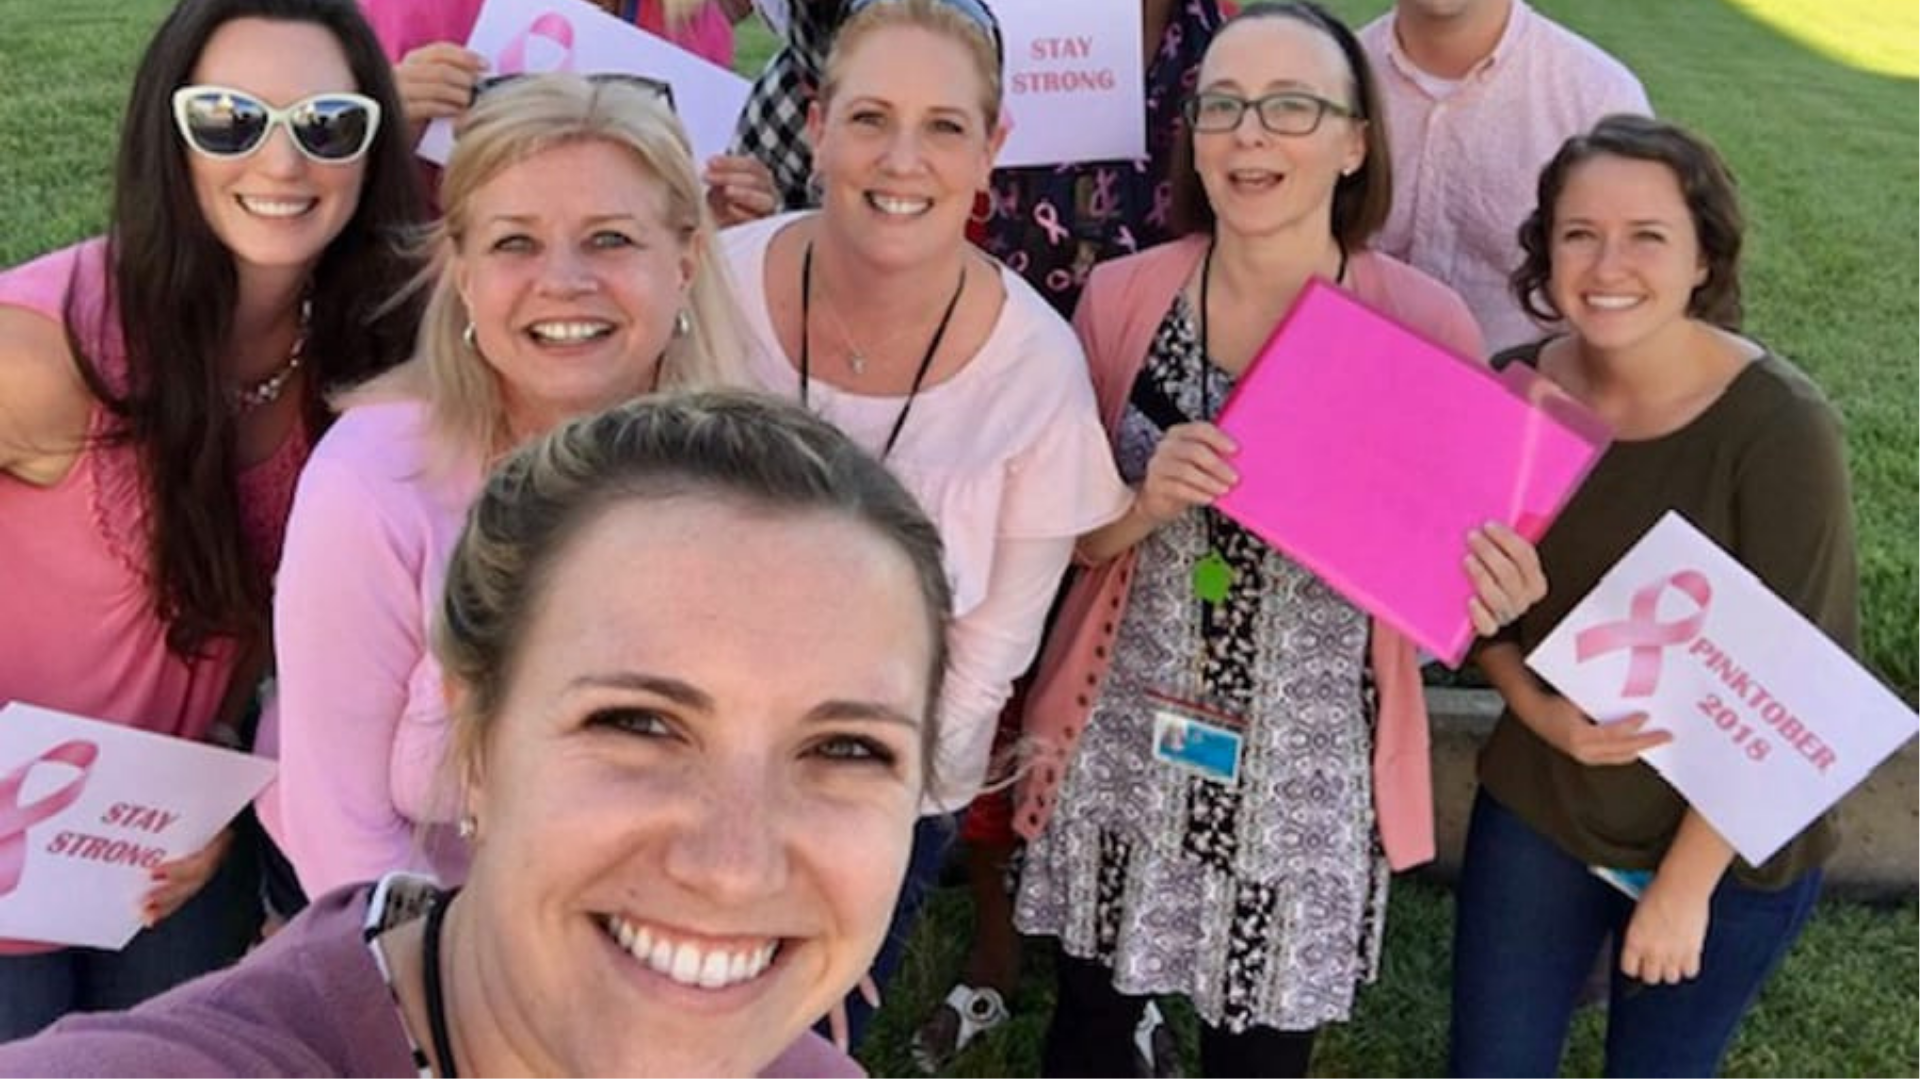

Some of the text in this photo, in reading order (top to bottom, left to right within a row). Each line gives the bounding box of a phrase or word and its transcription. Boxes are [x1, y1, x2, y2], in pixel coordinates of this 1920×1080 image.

[1030, 37, 1092, 60] STAY
[1012, 68, 1115, 94] STRONG
[1688, 637, 1837, 771] PINKTOBER
[1697, 693, 1771, 761] 2018
[101, 802, 180, 834] STAY
[47, 830, 166, 868] STRONG
